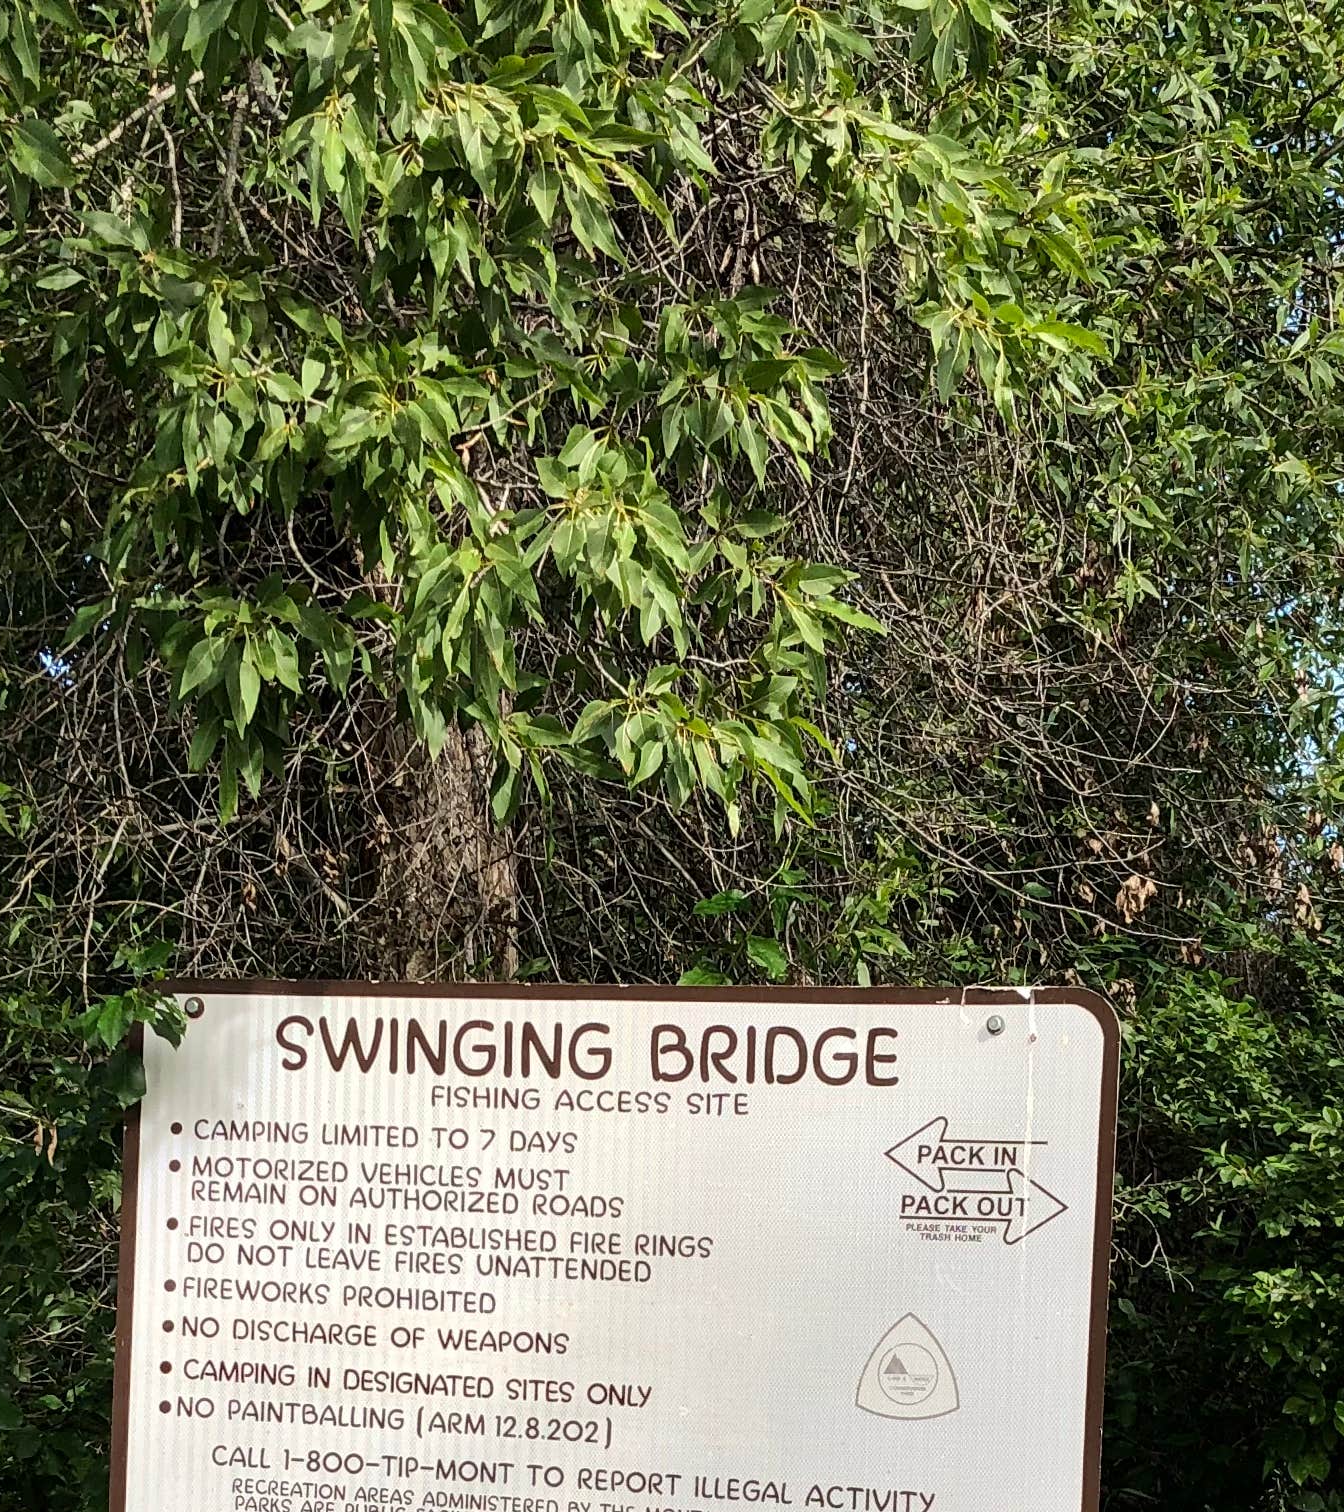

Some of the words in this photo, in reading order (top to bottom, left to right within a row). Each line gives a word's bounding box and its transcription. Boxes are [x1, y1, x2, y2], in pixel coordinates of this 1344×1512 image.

[275, 1015, 612, 1080] SWINGING
[650, 1023, 898, 1086] BRIDGE
[431, 1085, 540, 1110] FISHING
[554, 1089, 671, 1114] ACCESS
[686, 1092, 748, 1116] SITE
[193, 1118, 308, 1144] CAMPING
[321, 1123, 418, 1147] LIMITED
[431, 1126, 468, 1149] TO
[479, 1128, 495, 1150] 7
[509, 1130, 577, 1153] DAYS
[191, 1156, 348, 1182] MOTORIZED
[360, 1162, 482, 1188] VEHICLES
[494, 1167, 570, 1191] MUST
[917, 1145, 984, 1165] PACK
[993, 1146, 1016, 1165] IN
[191, 1181, 286, 1204] REMAIN
[298, 1184, 336, 1207] ON
[349, 1186, 518, 1214] AUTHORIZED
[532, 1192, 624, 1218] ROADS
[900, 1194, 968, 1215] PACK
[976, 1196, 1024, 1216] OUT
[189, 1215, 256, 1239] FIRES
[269, 1219, 335, 1242] ONLY
[348, 1222, 371, 1244] IN
[384, 1223, 556, 1252] ESTABLISHED
[569, 1231, 621, 1255] FIRE
[634, 1233, 713, 1258] RINGS
[905, 1223, 940, 1232] PLEASE
[944, 1224, 967, 1233] TAKE
[971, 1225, 997, 1234] YOUR
[919, 1233, 950, 1241] TRASH
[954, 1233, 981, 1243] HOME
[187, 1242, 224, 1263] DO
[237, 1244, 293, 1267] NOT
[305, 1247, 380, 1271] LEAVE
[394, 1250, 463, 1274] FIRES
[476, 1253, 651, 1282] UNATTENDED
[183, 1276, 330, 1304] FIREWORKS
[342, 1284, 496, 1314] PROHIBITED
[181, 1315, 219, 1338] NO
[232, 1318, 376, 1346] DISCHARGE
[390, 1326, 424, 1348] OF
[437, 1328, 569, 1354] WEAPONS
[183, 1358, 295, 1386] CAMPING
[307, 1365, 330, 1388] IN
[343, 1368, 493, 1398] DESIGNATED
[505, 1378, 574, 1403] SITES
[586, 1382, 652, 1407] ONLY
[176, 1395, 214, 1418] NO
[227, 1398, 404, 1430] PAINTBALLING
[416, 1406, 485, 1437] (ARM
[495, 1415, 612, 1448] 12.8.202)
[211, 1445, 270, 1468] CALL
[283, 1449, 514, 1484] 1-800-TIP-MONT
[526, 1464, 564, 1487] TO
[577, 1468, 682, 1496] REPORT
[694, 1475, 792, 1504] ILLEGAL
[231, 1478, 346, 1502] RECREATION
[354, 1487, 414, 1506] AREAS
